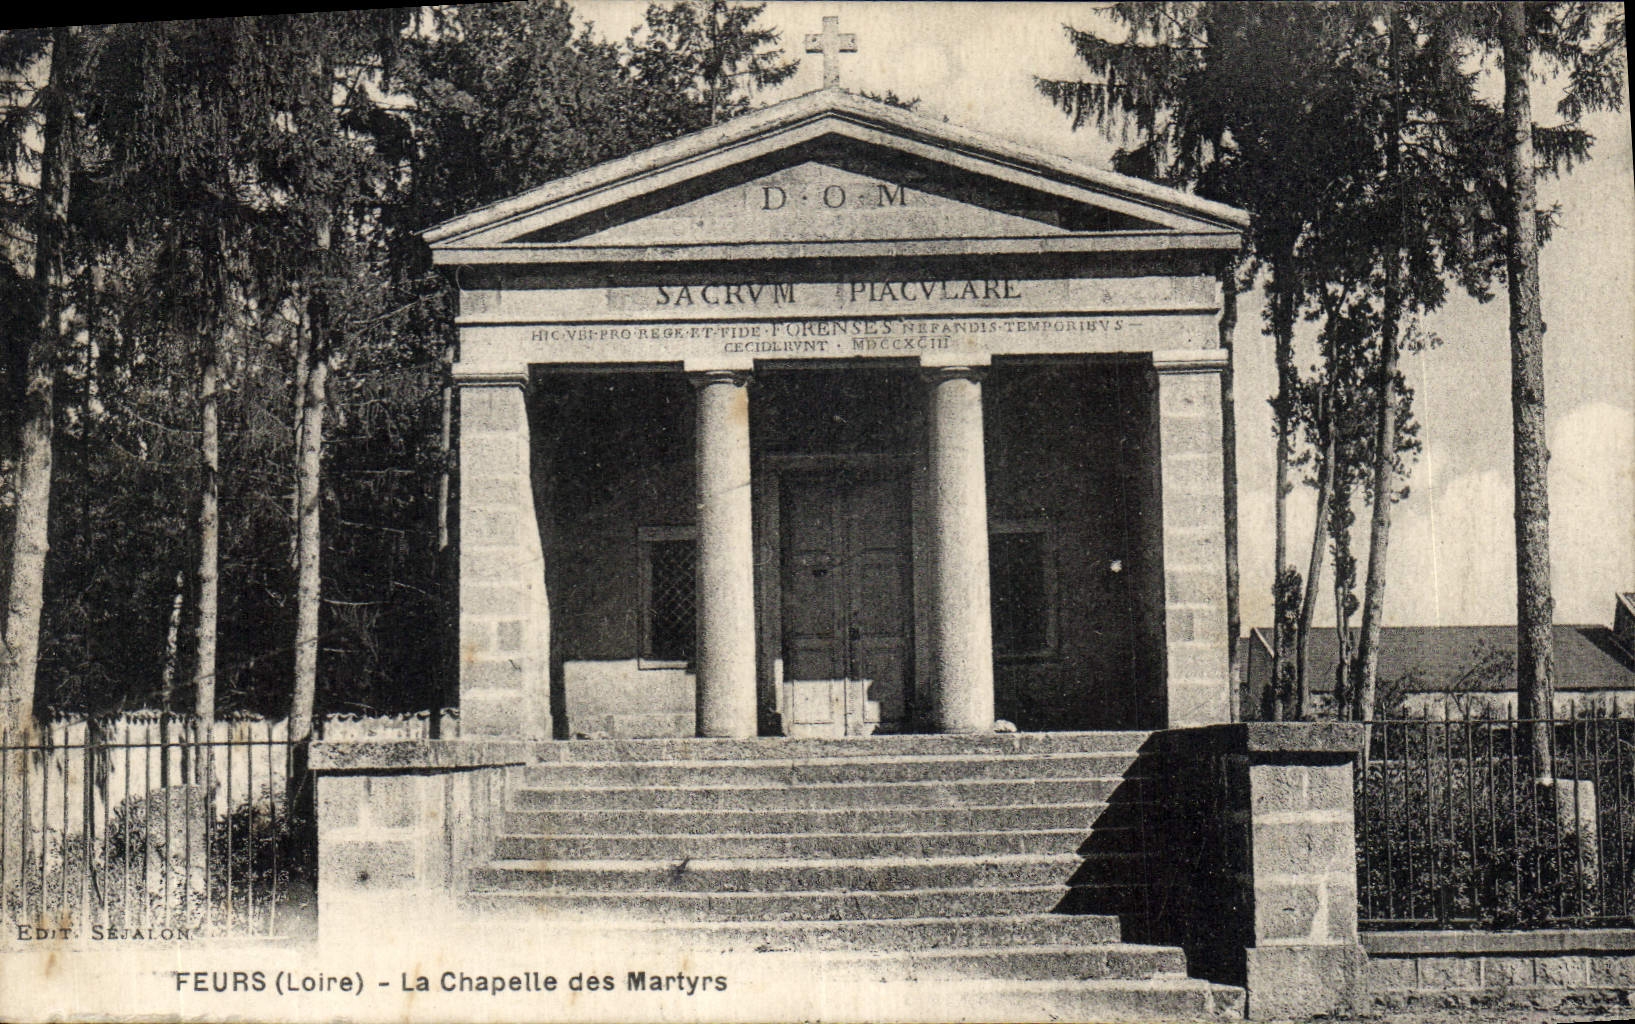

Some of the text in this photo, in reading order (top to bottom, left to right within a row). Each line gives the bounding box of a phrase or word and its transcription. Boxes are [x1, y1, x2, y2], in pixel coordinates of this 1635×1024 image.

[656, 279, 1022, 306] SACRVM PIACVLARE
[532, 329, 560, 341] HIC
[770, 320, 892, 337] FORENSES
